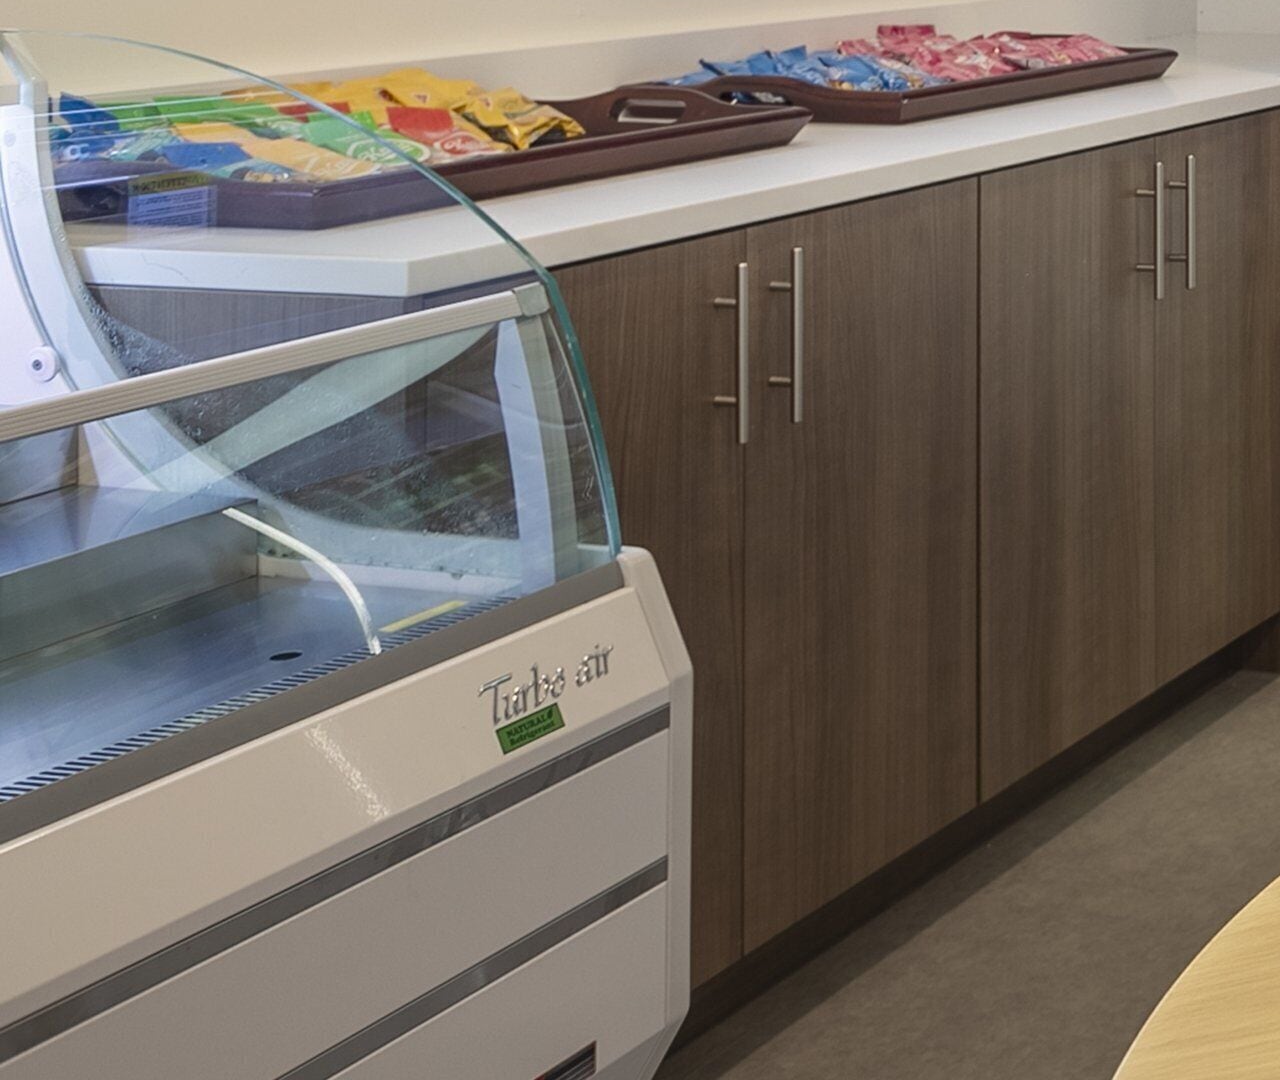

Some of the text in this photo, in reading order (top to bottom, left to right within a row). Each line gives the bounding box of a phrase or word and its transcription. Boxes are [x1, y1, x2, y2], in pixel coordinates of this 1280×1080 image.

[477, 643, 614, 725] Turbo air
[506, 713, 548, 737] NATURAL
